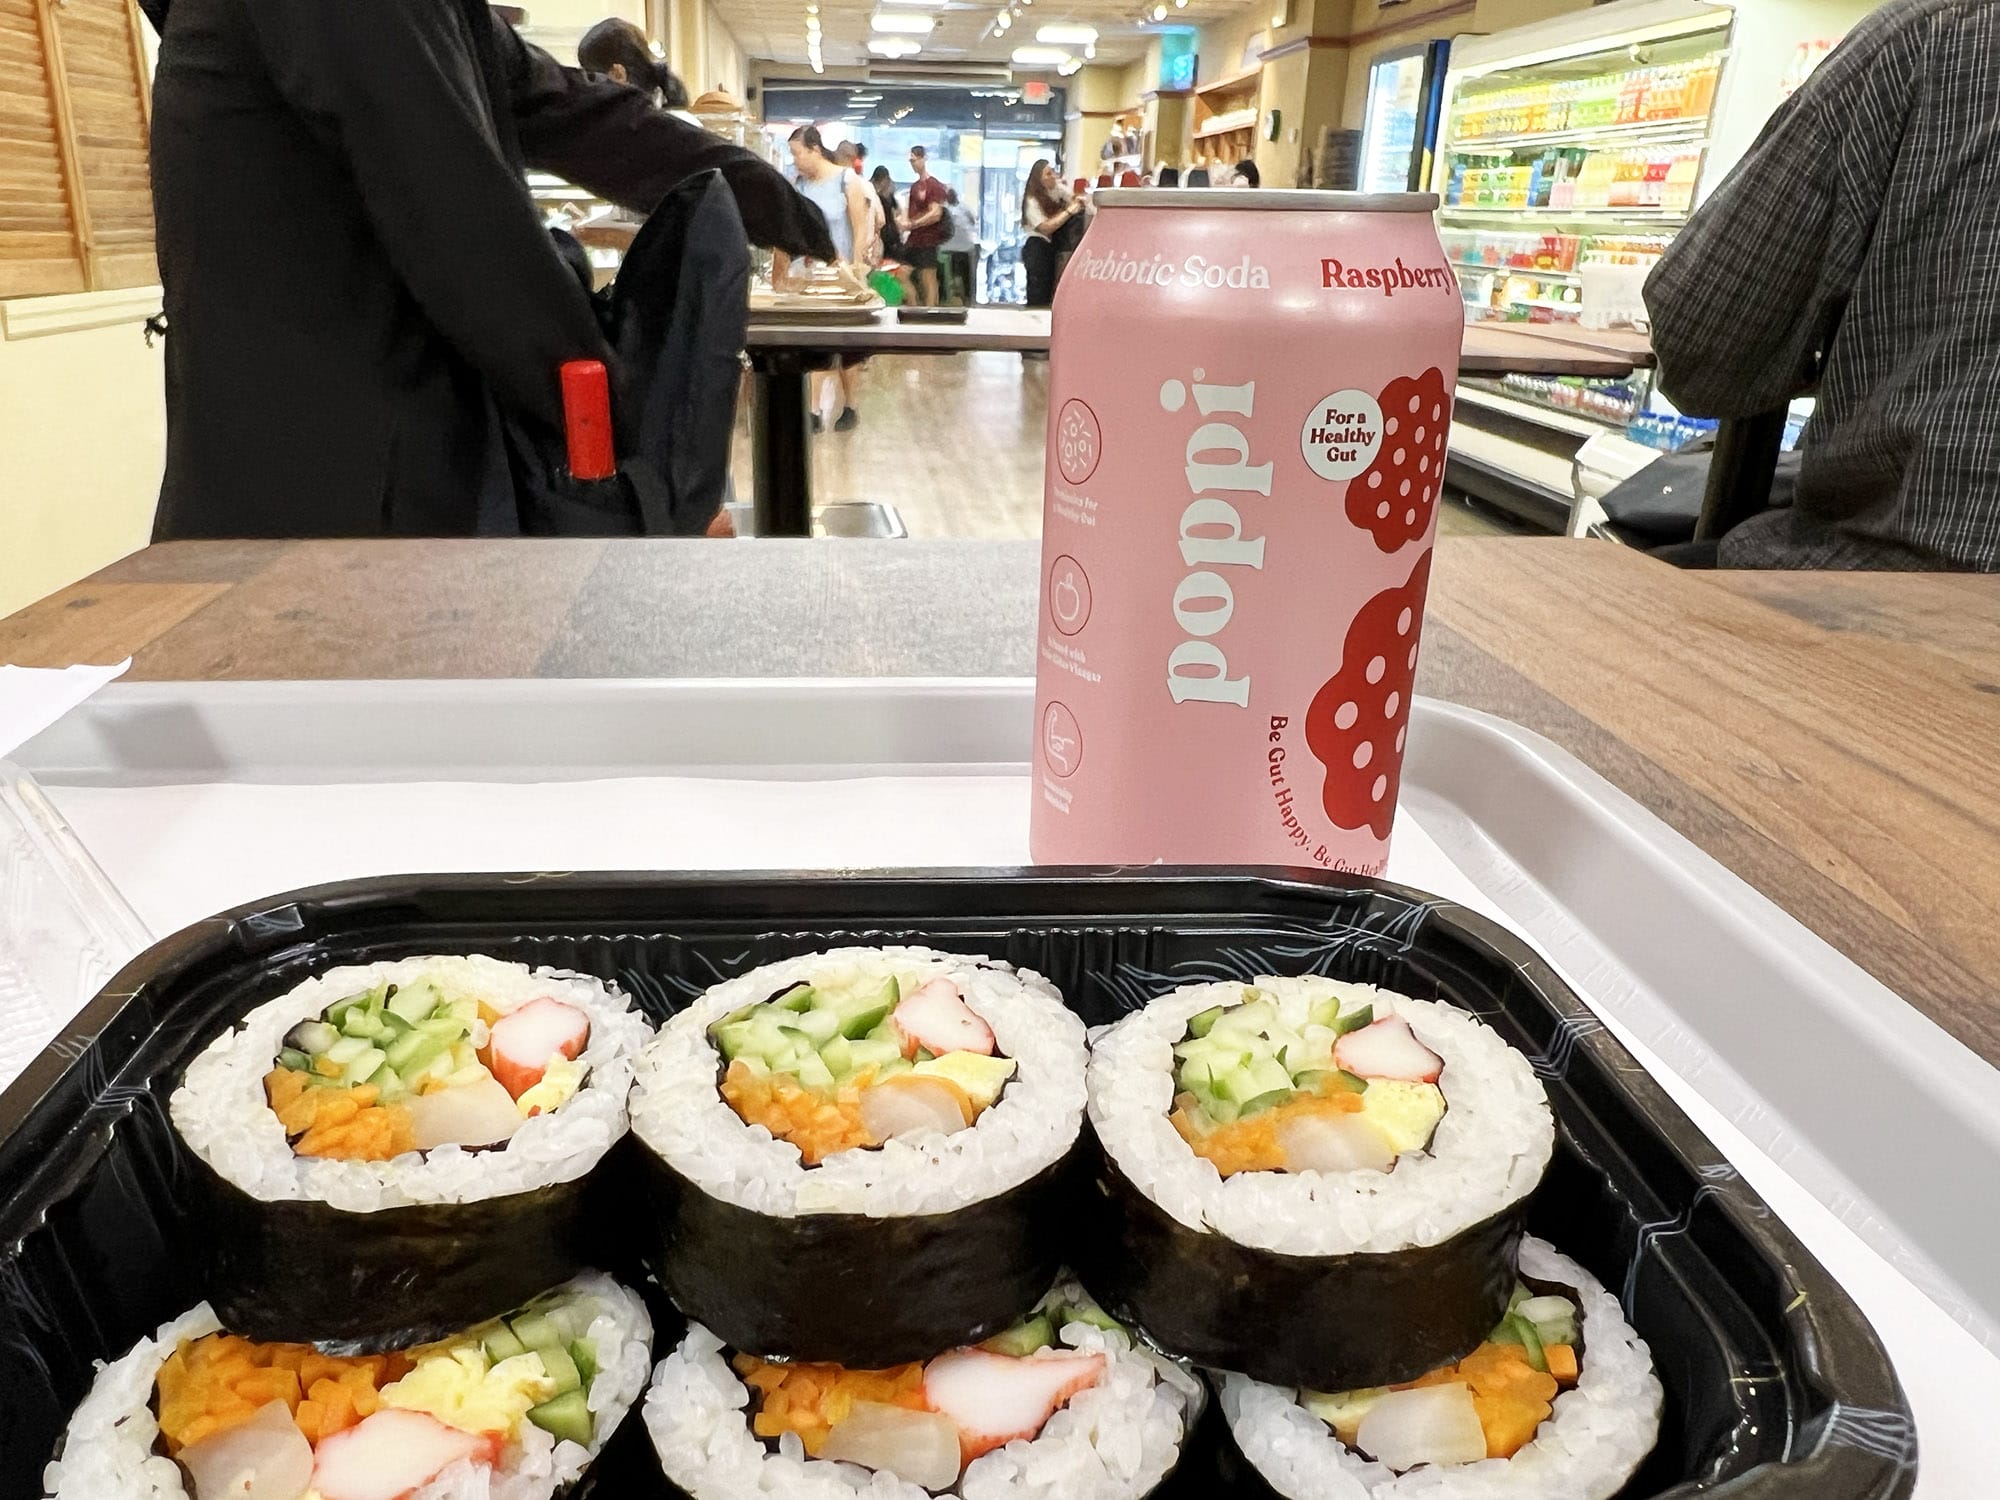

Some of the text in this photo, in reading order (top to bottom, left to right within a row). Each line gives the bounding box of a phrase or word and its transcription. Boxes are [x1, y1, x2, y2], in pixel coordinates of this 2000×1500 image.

[1180, 255, 1270, 289] Soda
[1321, 257, 1450, 296] Raspberry
[1325, 409, 1366, 425] For a
[1310, 427, 1376, 446] Healthy
[1327, 447, 1357, 462] Gut
[1159, 379, 1274, 708] poppi
[1268, 715, 1289, 742] Be
[1268, 747, 1286, 786] Gut
[1275, 788, 1312, 851] Happy.
[1313, 845, 1331, 867] Be
